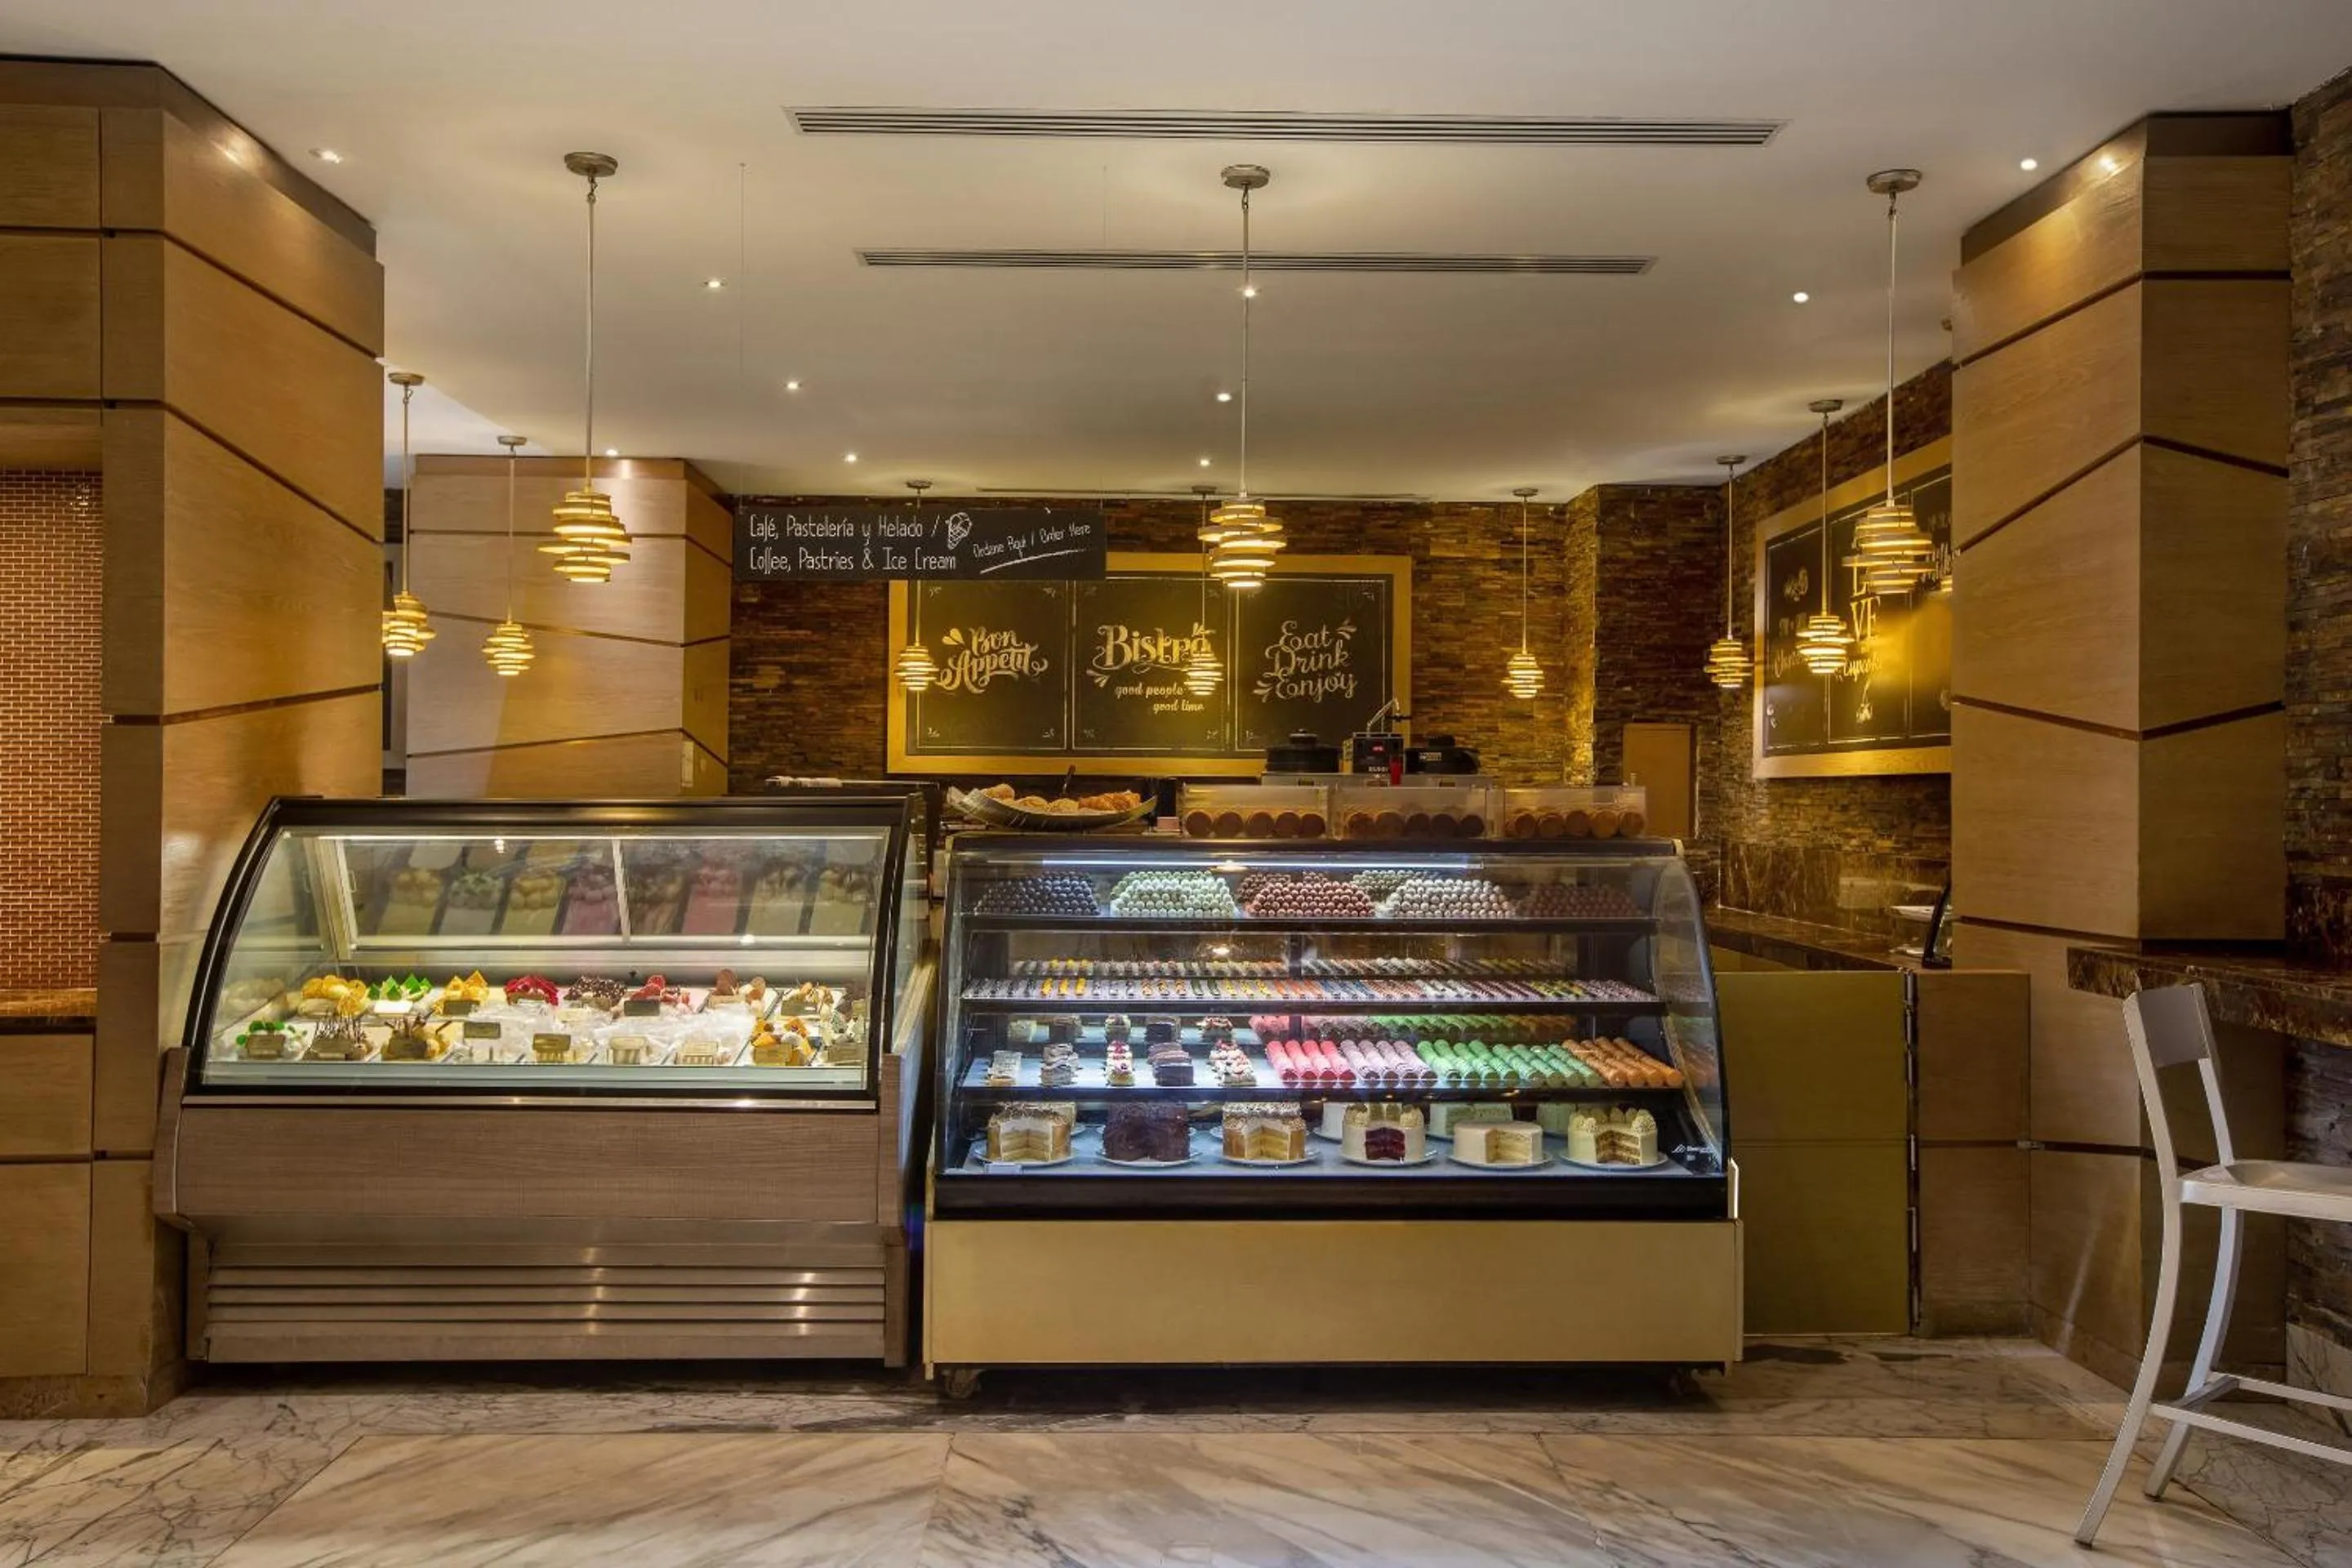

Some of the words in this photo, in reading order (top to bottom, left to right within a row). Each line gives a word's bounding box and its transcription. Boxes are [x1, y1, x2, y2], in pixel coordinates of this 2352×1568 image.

[750, 514, 778, 542] Café,
[786, 514, 854, 537] Pastelería
[862, 523, 871, 546] y
[879, 514, 927, 537] Helado
[1039, 526, 1065, 544] Order
[1068, 521, 1091, 537] Here
[750, 546, 791, 574] Coffee,
[799, 546, 854, 571] Pastries
[862, 547, 875, 571] &
[882, 546, 907, 571] Ice
[915, 546, 956, 571] Cream
[969, 626, 1023, 657] Bon
[1278, 620, 1333, 653] Eat
[934, 643, 1049, 694] Appetit
[1263, 639, 1349, 678] Drink
[1116, 683, 1143, 698] good
[1145, 683, 1185, 699] people
[1276, 667, 1357, 703] Enjoy
[1152, 699, 1180, 715] good
